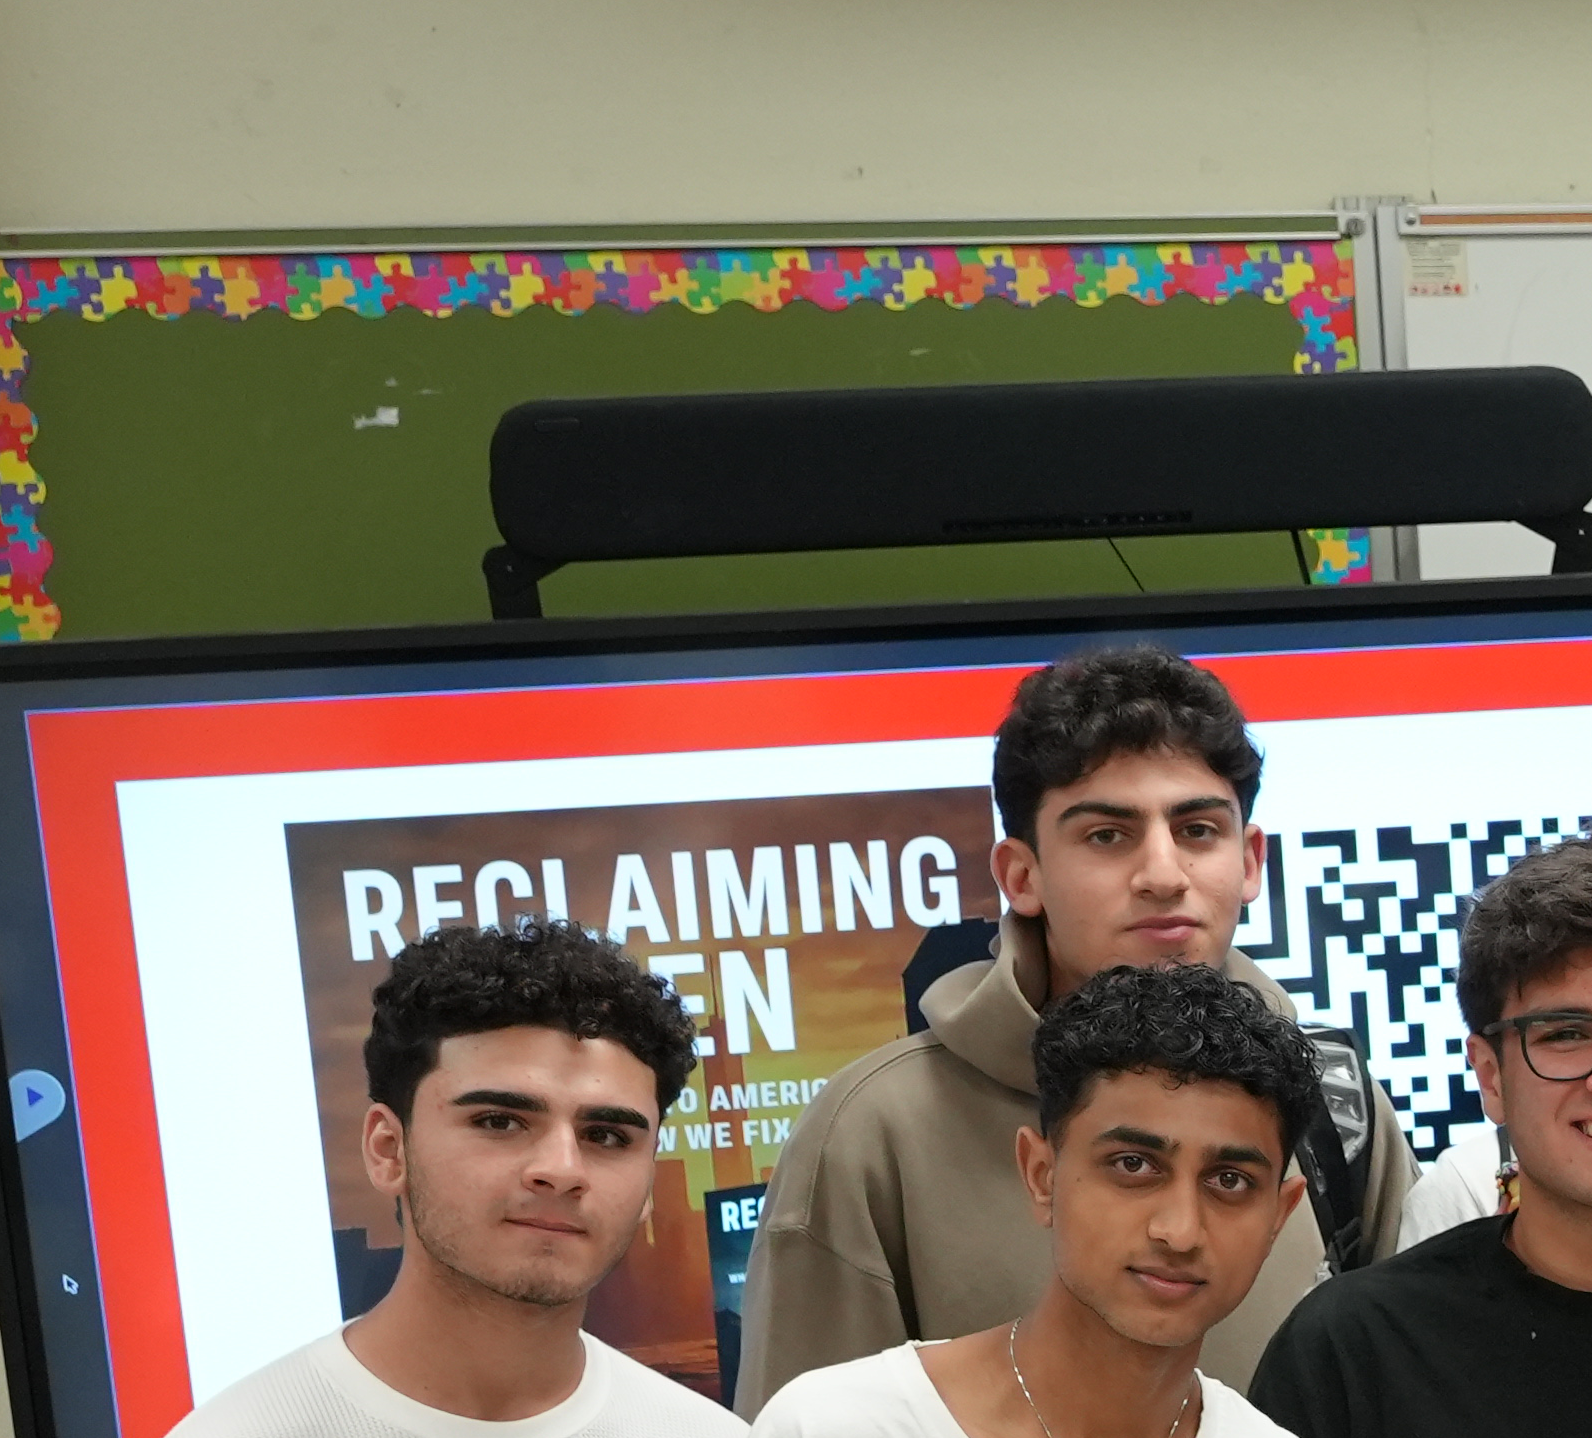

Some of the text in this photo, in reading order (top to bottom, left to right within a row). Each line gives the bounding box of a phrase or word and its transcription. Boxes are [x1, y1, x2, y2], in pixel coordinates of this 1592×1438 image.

[648, 947, 796, 1057] EN
[710, 1078, 829, 1112] AMERIC
[684, 1121, 733, 1150] WE
[742, 1117, 791, 1146] FIX
